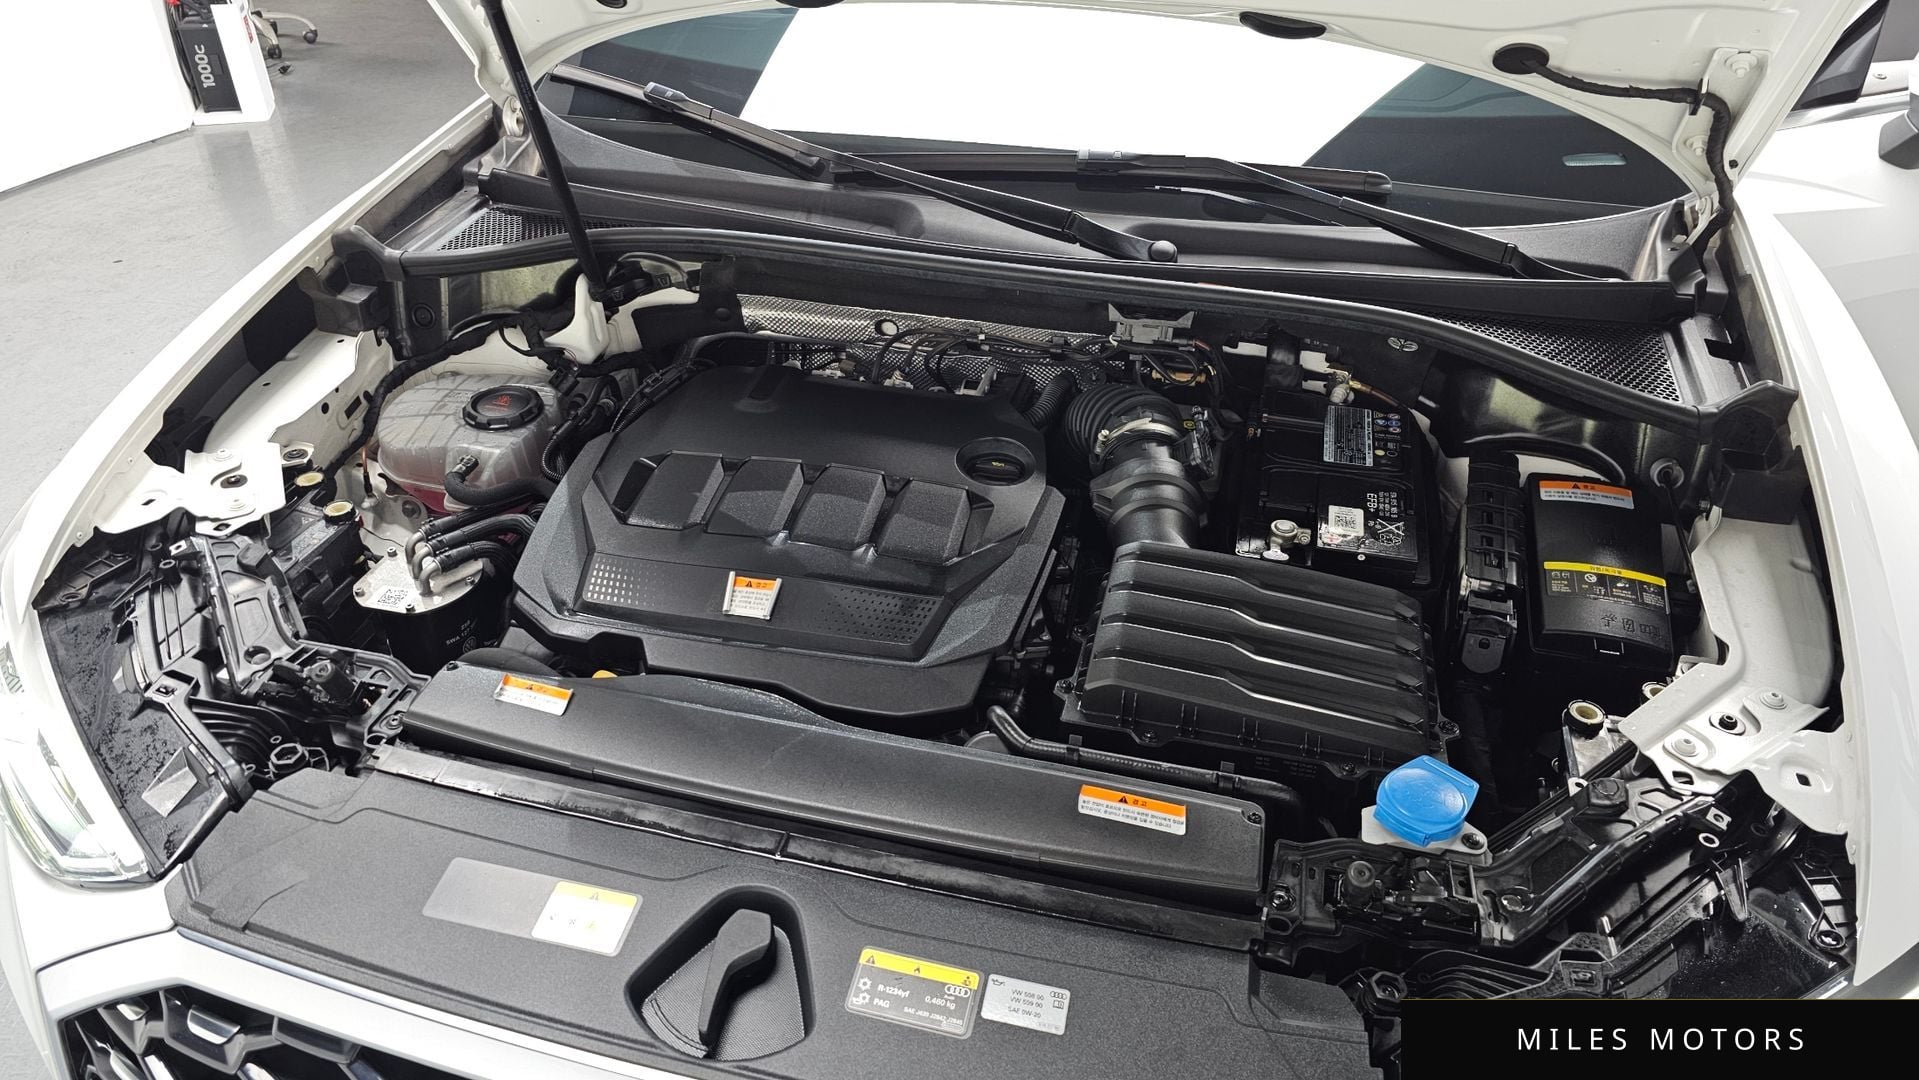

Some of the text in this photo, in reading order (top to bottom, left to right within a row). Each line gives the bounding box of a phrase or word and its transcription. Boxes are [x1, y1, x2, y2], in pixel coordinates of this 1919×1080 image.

[1366, 493, 1378, 512] EFB+
[873, 998, 890, 1008] PAG
[946, 1001, 956, 1010] kg
